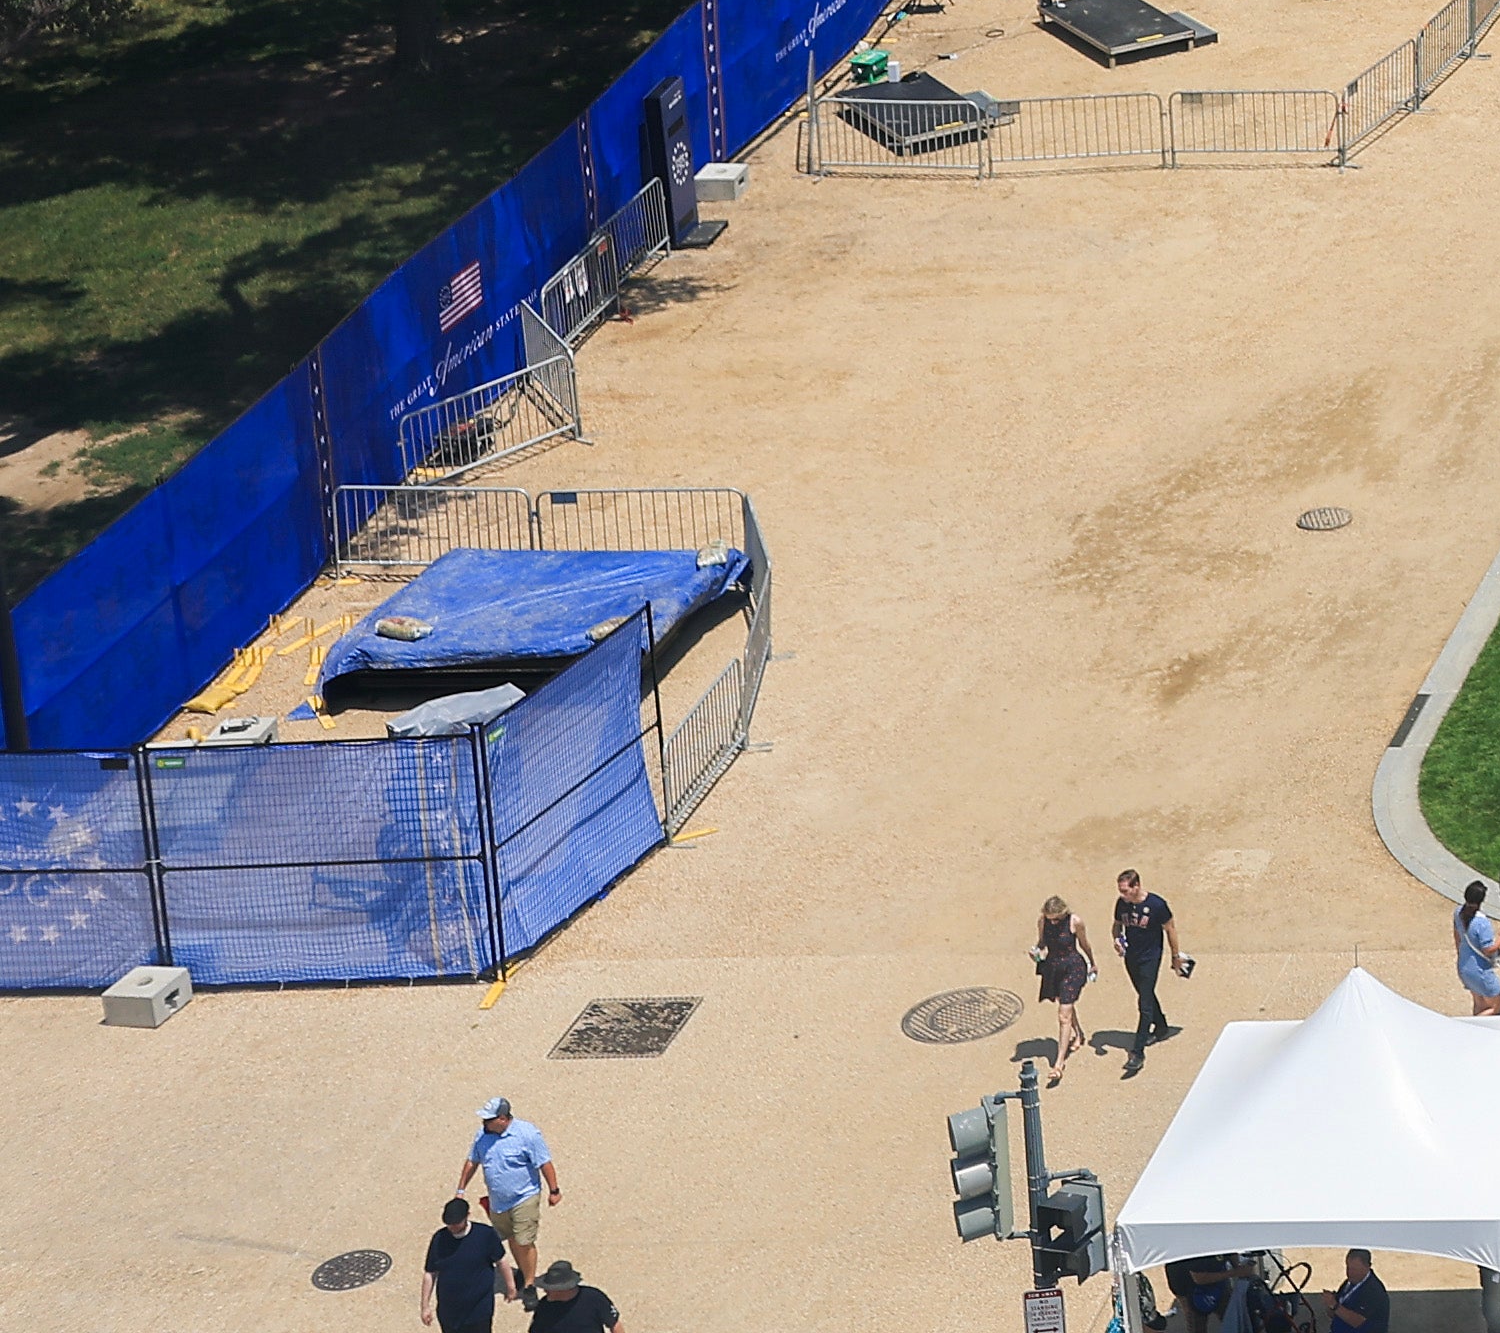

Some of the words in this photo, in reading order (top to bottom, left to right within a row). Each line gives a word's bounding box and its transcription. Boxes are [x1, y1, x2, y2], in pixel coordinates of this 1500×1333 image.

[389, 399, 405, 421] THE
[407, 374, 432, 406] GREAT
[428, 324, 494, 398] American
[495, 302, 522, 332] STATE
